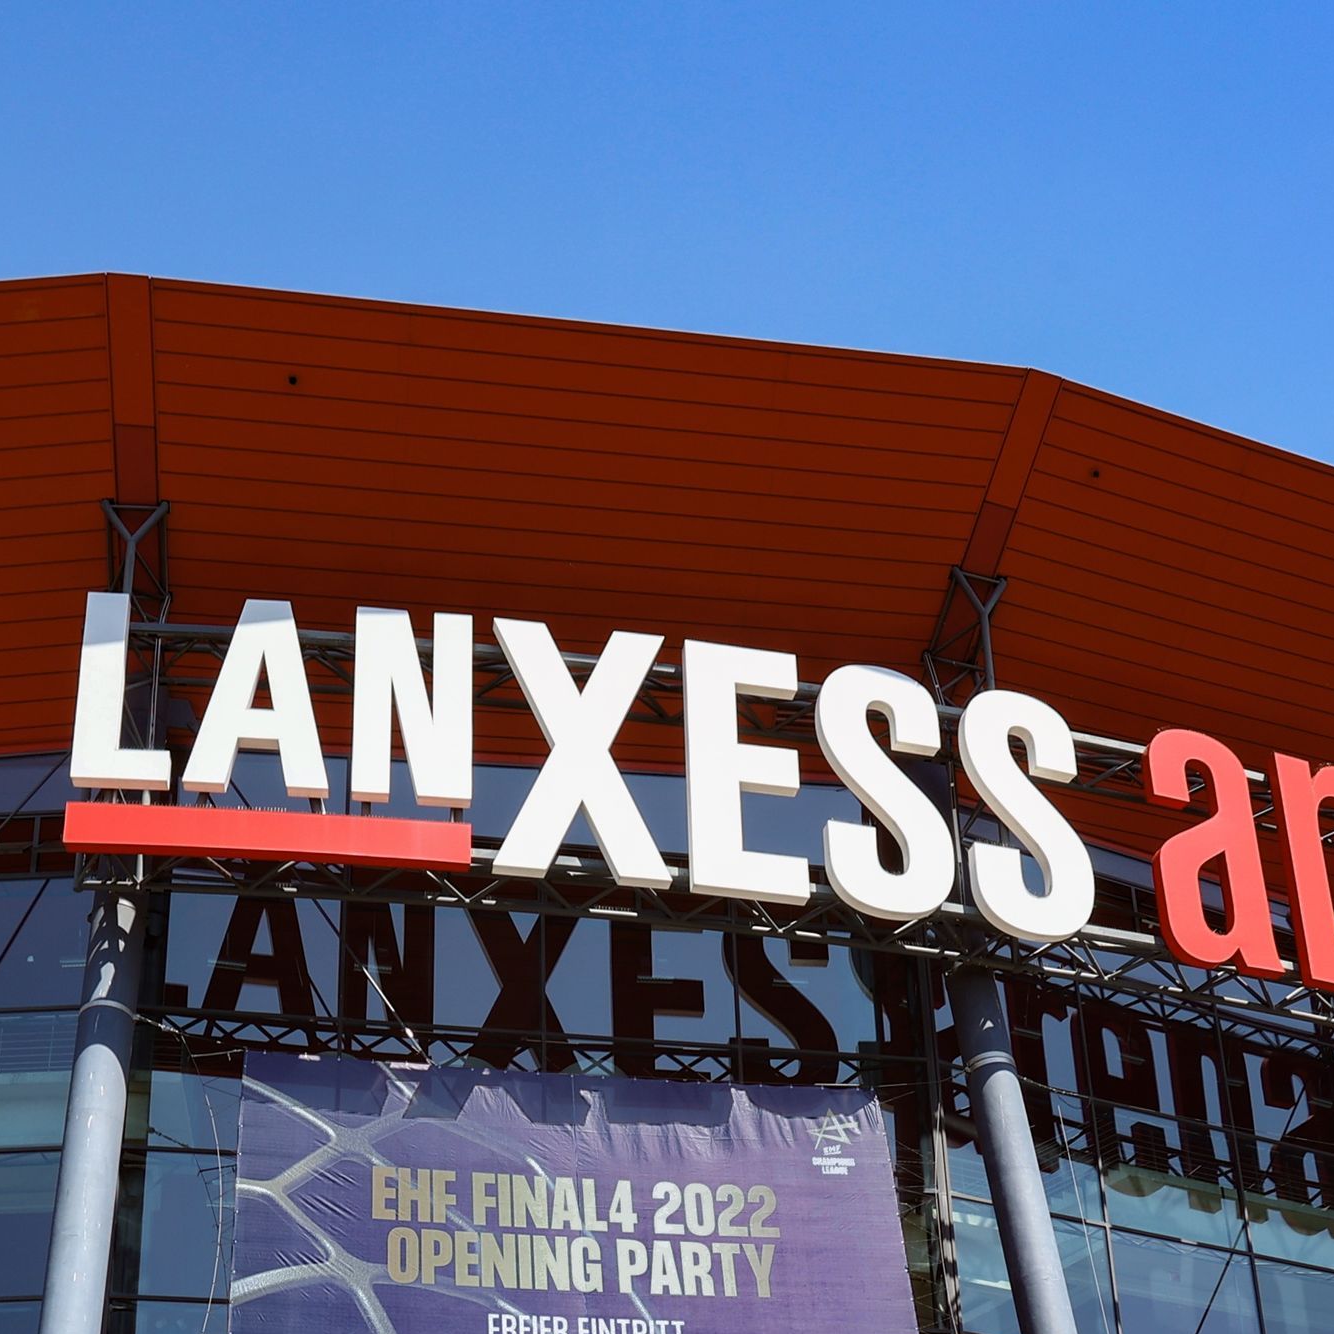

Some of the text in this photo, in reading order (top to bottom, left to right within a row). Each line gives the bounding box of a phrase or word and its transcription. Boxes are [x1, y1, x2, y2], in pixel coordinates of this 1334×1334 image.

[69, 591, 1097, 944] LANXESS
[371, 1165, 782, 1240] EHF FINAL4 2022
[386, 1226, 775, 1299] OPENING PARTY
